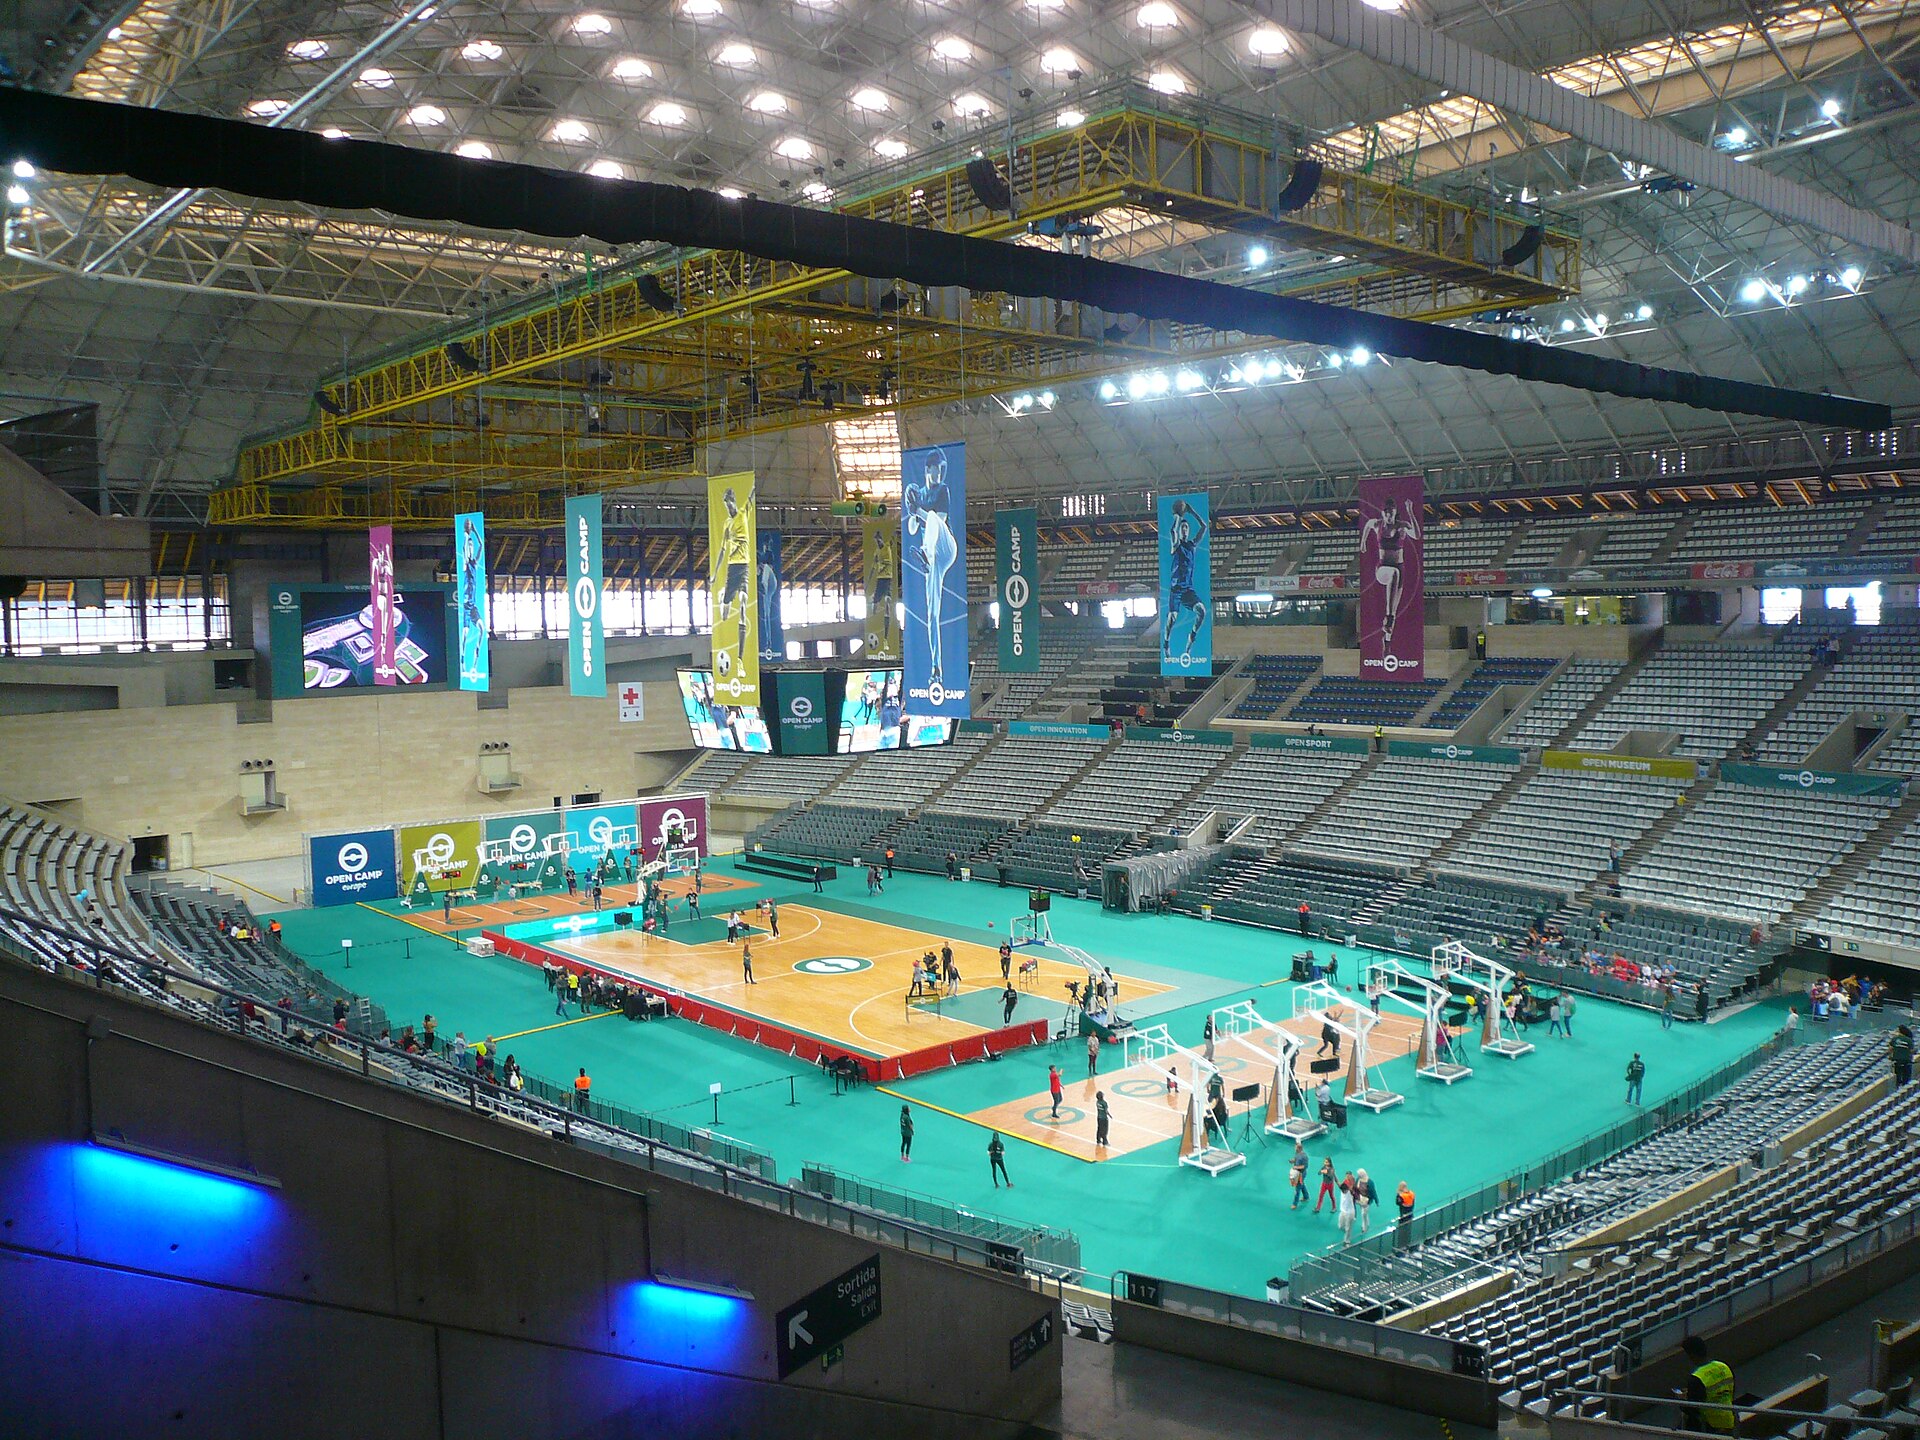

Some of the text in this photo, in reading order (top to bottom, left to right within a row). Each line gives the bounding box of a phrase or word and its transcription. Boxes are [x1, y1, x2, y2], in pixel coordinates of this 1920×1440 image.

[579, 516, 592, 677] OPEN CAMP
[1011, 527, 1023, 656] OPEN CAMP
[1191, 657, 1208, 665] CAMP
[1363, 659, 1419, 668] OPEN CAMP
[716, 682, 731, 691] OPEN
[910, 688, 967, 700] OPEN CAMP
[1046, 726, 1088, 735] INNOVATION
[1285, 738, 1332, 748] OPEN SPORT
[1582, 757, 1651, 772] OPEN MUSEUM
[1778, 773, 1836, 784] OPEN CAMP
[578, 845, 601, 854] OPEN
[325, 870, 383, 885] OPEN CAMP
[342, 880, 367, 893] europe
[837, 1267, 876, 1299] Sortida
[850, 1284, 877, 1307] Salida
[1131, 1283, 1156, 1299] 117
[861, 1300, 877, 1318] Exit
[1458, 1354, 1480, 1368] 117
